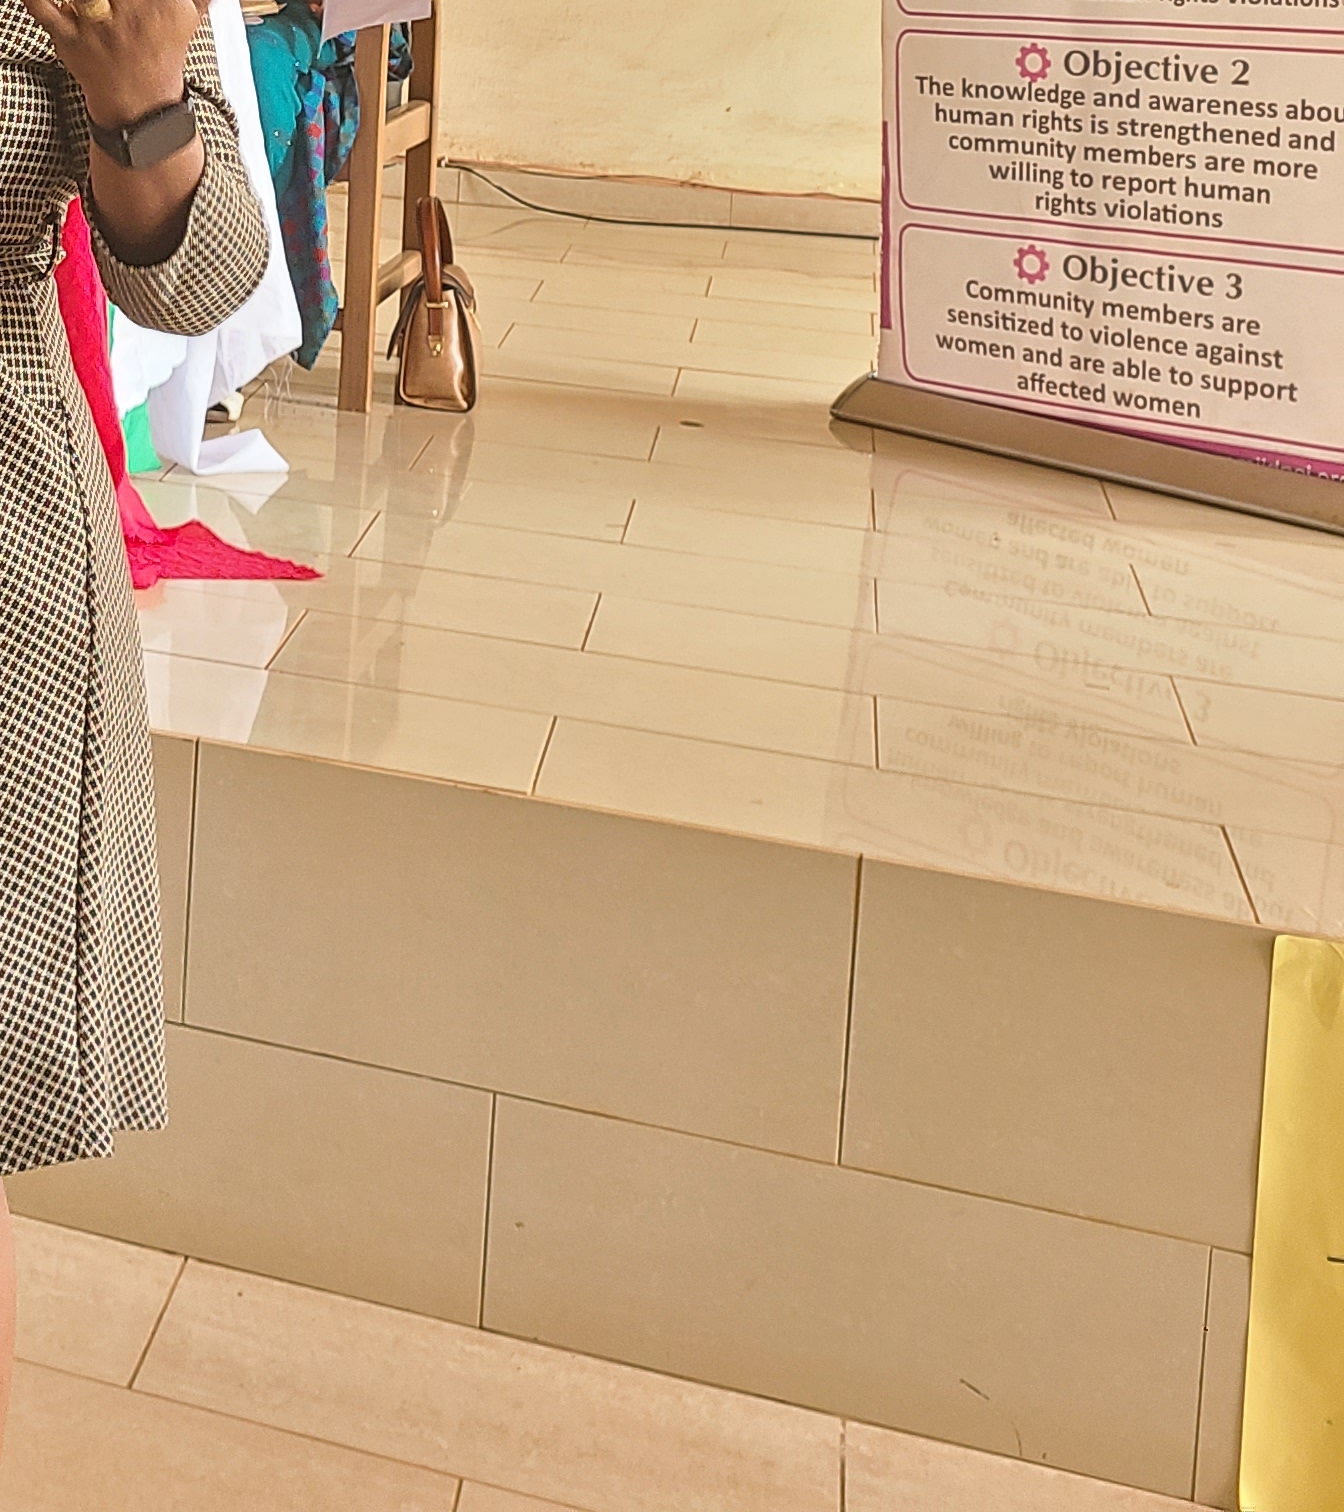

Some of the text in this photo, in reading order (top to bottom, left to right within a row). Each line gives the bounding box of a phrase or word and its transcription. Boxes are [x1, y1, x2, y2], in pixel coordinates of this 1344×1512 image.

[1063, 48, 1250, 87] Objective 2
[1062, 254, 1243, 300] Objective 3
[965, 279, 1261, 337] Community members are
[947, 308, 1284, 370] sensitized to violence against
[935, 333, 1299, 403] women and are able to support
[1016, 371, 1201, 419] affected women
